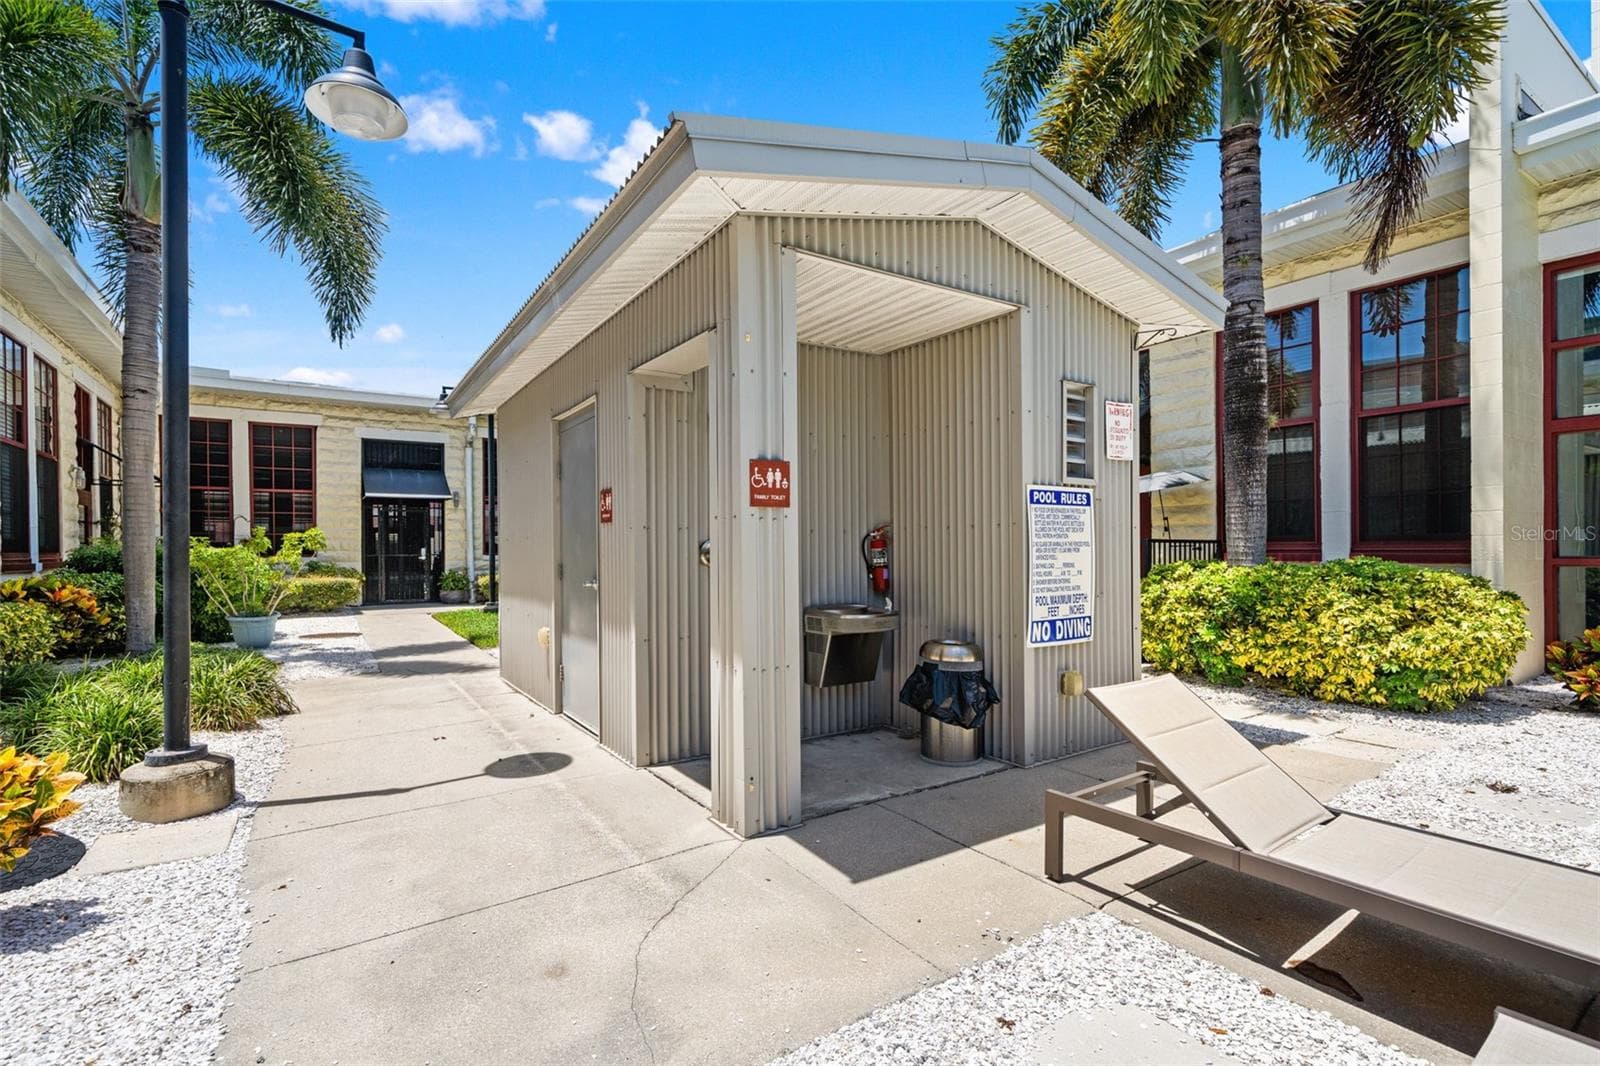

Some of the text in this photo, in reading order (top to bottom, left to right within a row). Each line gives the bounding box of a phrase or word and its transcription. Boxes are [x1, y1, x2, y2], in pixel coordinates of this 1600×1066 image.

[1033, 491, 1088, 505] POOL RULES
[1035, 595, 1050, 606] POOL
[1048, 606, 1060, 617] FEET
[1032, 617, 1091, 643] NO DIVING
